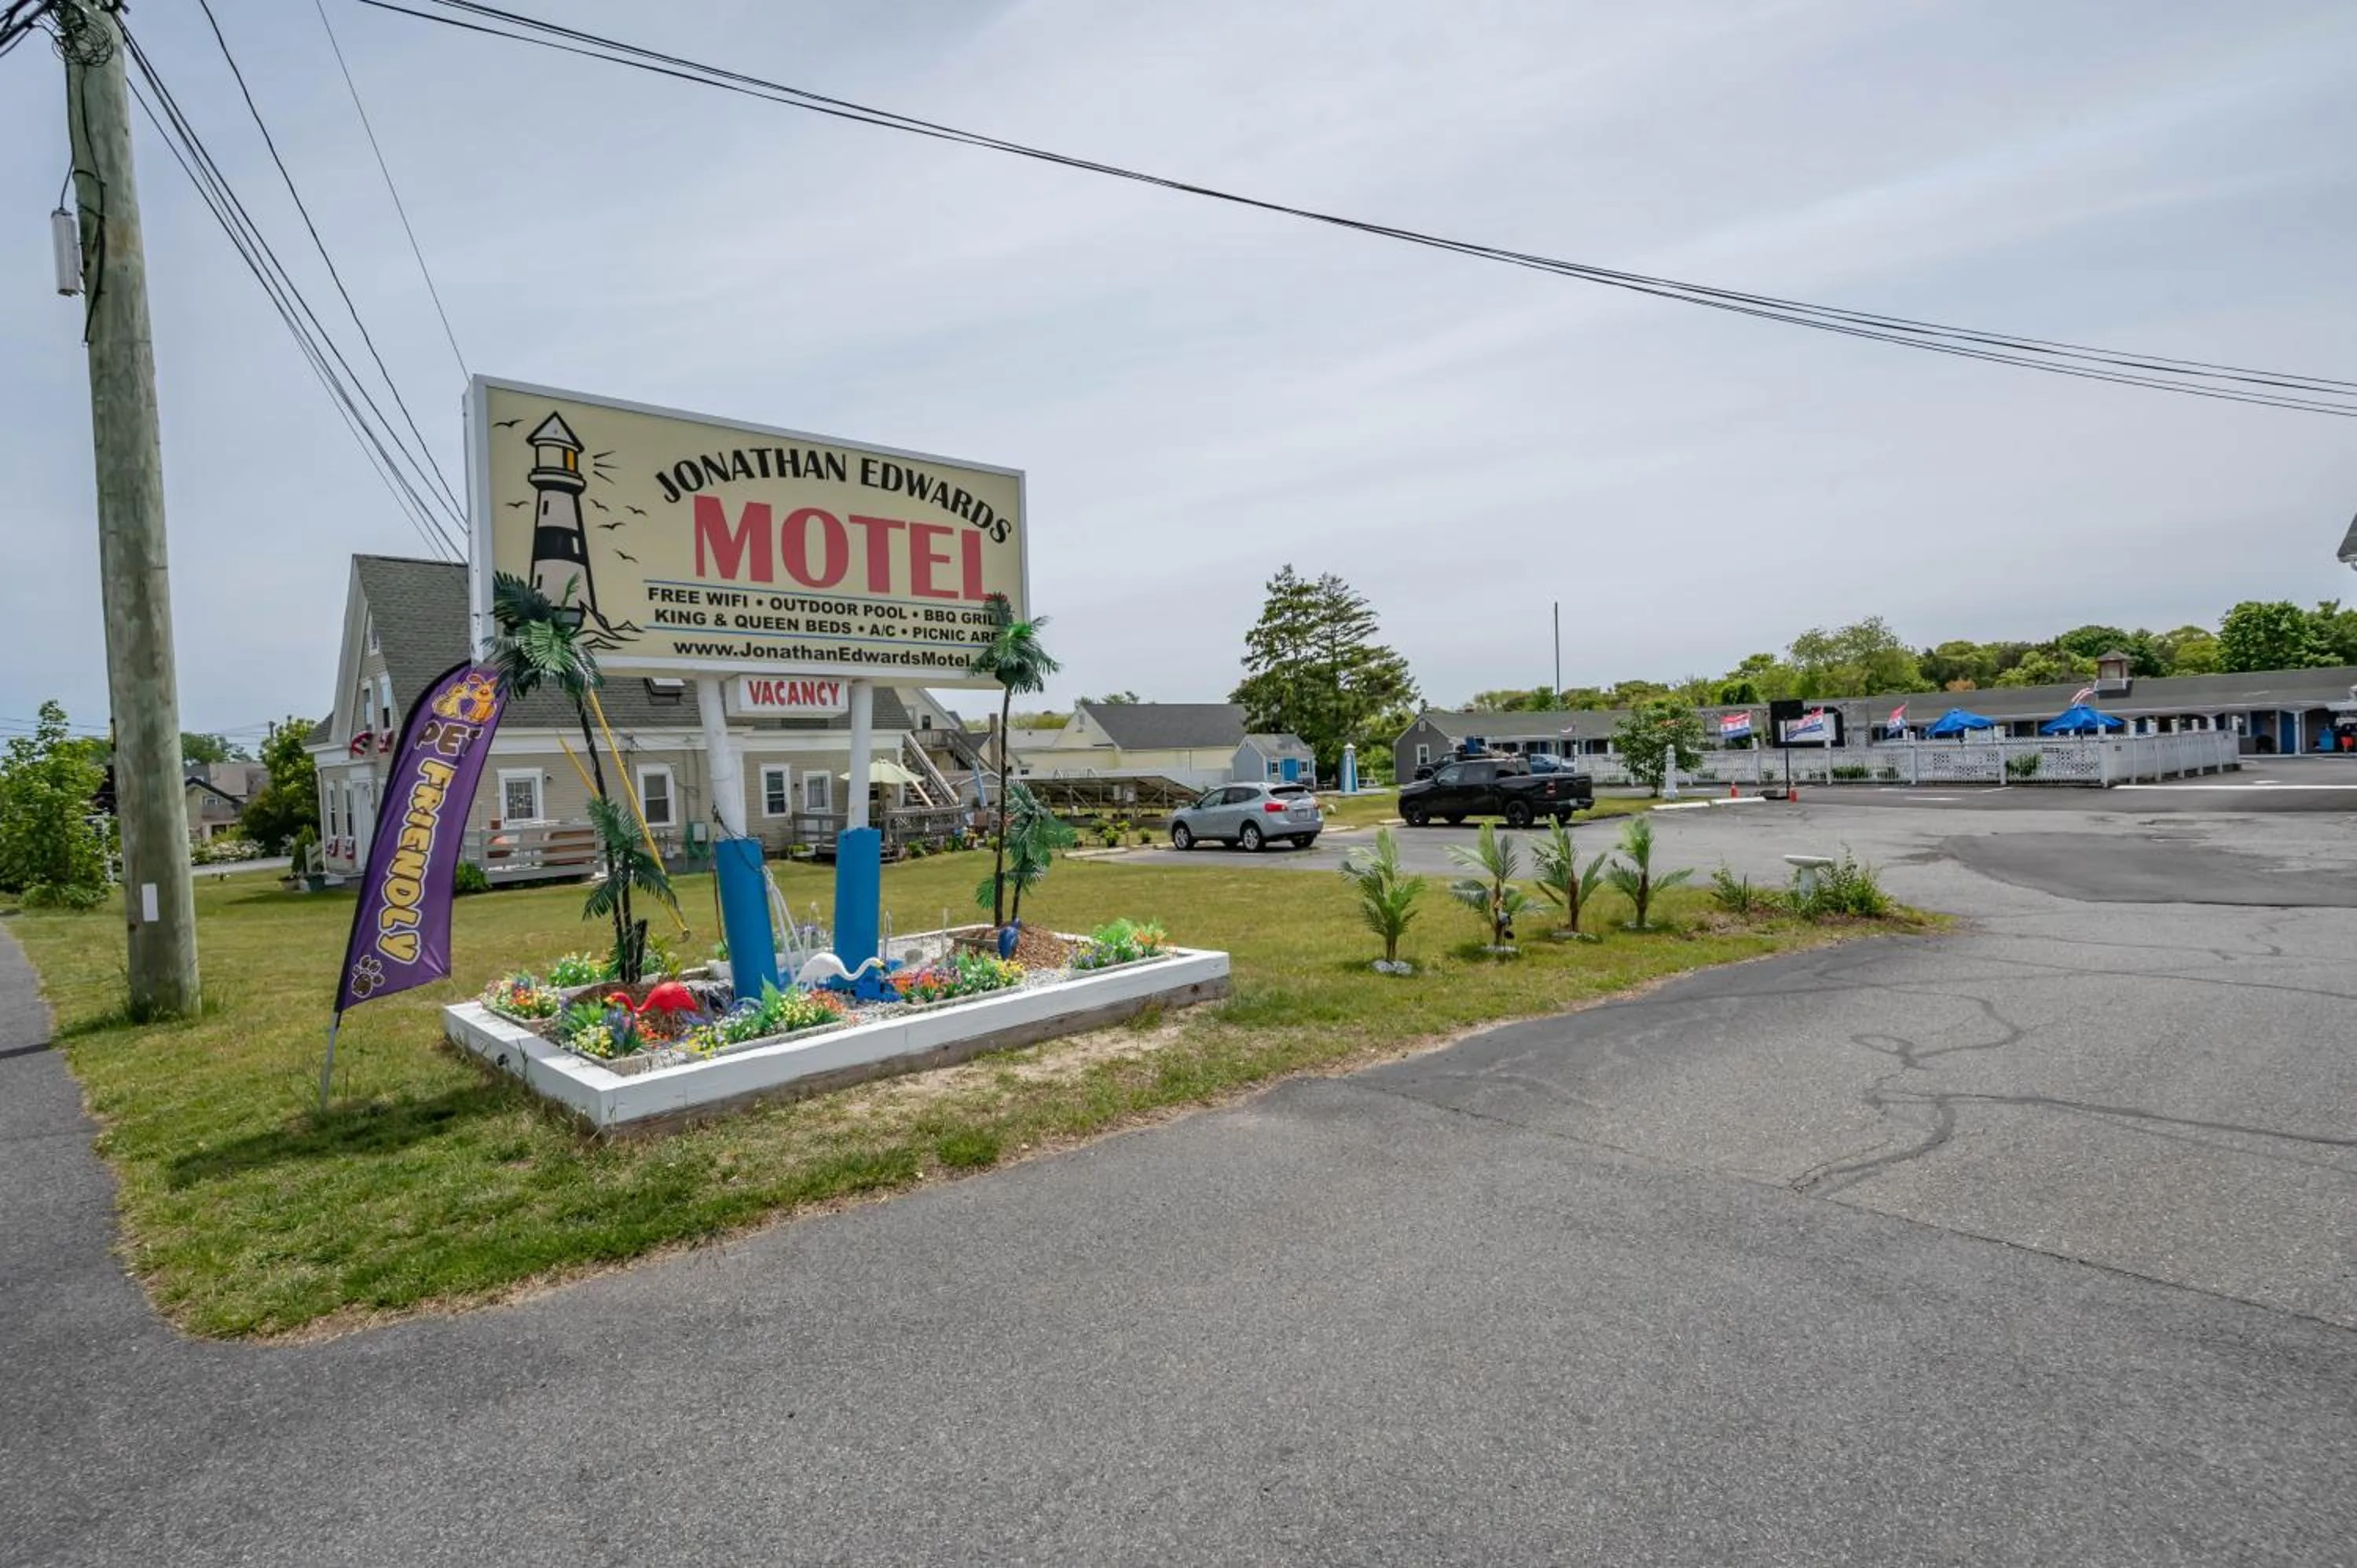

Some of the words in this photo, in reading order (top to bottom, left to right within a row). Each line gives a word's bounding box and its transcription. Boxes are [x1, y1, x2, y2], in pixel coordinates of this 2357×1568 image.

[654, 447, 847, 504] JONATHAN
[860, 457, 1012, 544] EDWARDS
[693, 494, 1004, 602] MOTEL
[647, 587, 700, 604] FREE
[706, 592, 748, 608] WIFI
[769, 597, 858, 616] OUTDOOR
[863, 604, 907, 620] POOL
[924, 609, 956, 624] BBQ
[961, 611, 1006, 626] GRIL
[654, 608, 706, 626] KING
[713, 613, 728, 627] &
[734, 614, 800, 632] QUEEN
[805, 619, 852, 635] BEDS
[869, 624, 896, 638] A/C
[912, 627, 966, 641] PICNIC
[970, 630, 1007, 644] ARE
[747, 680, 841, 705] VACANCY
[413, 720, 484, 757] PET
[377, 757, 457, 965] FRIENDLY
